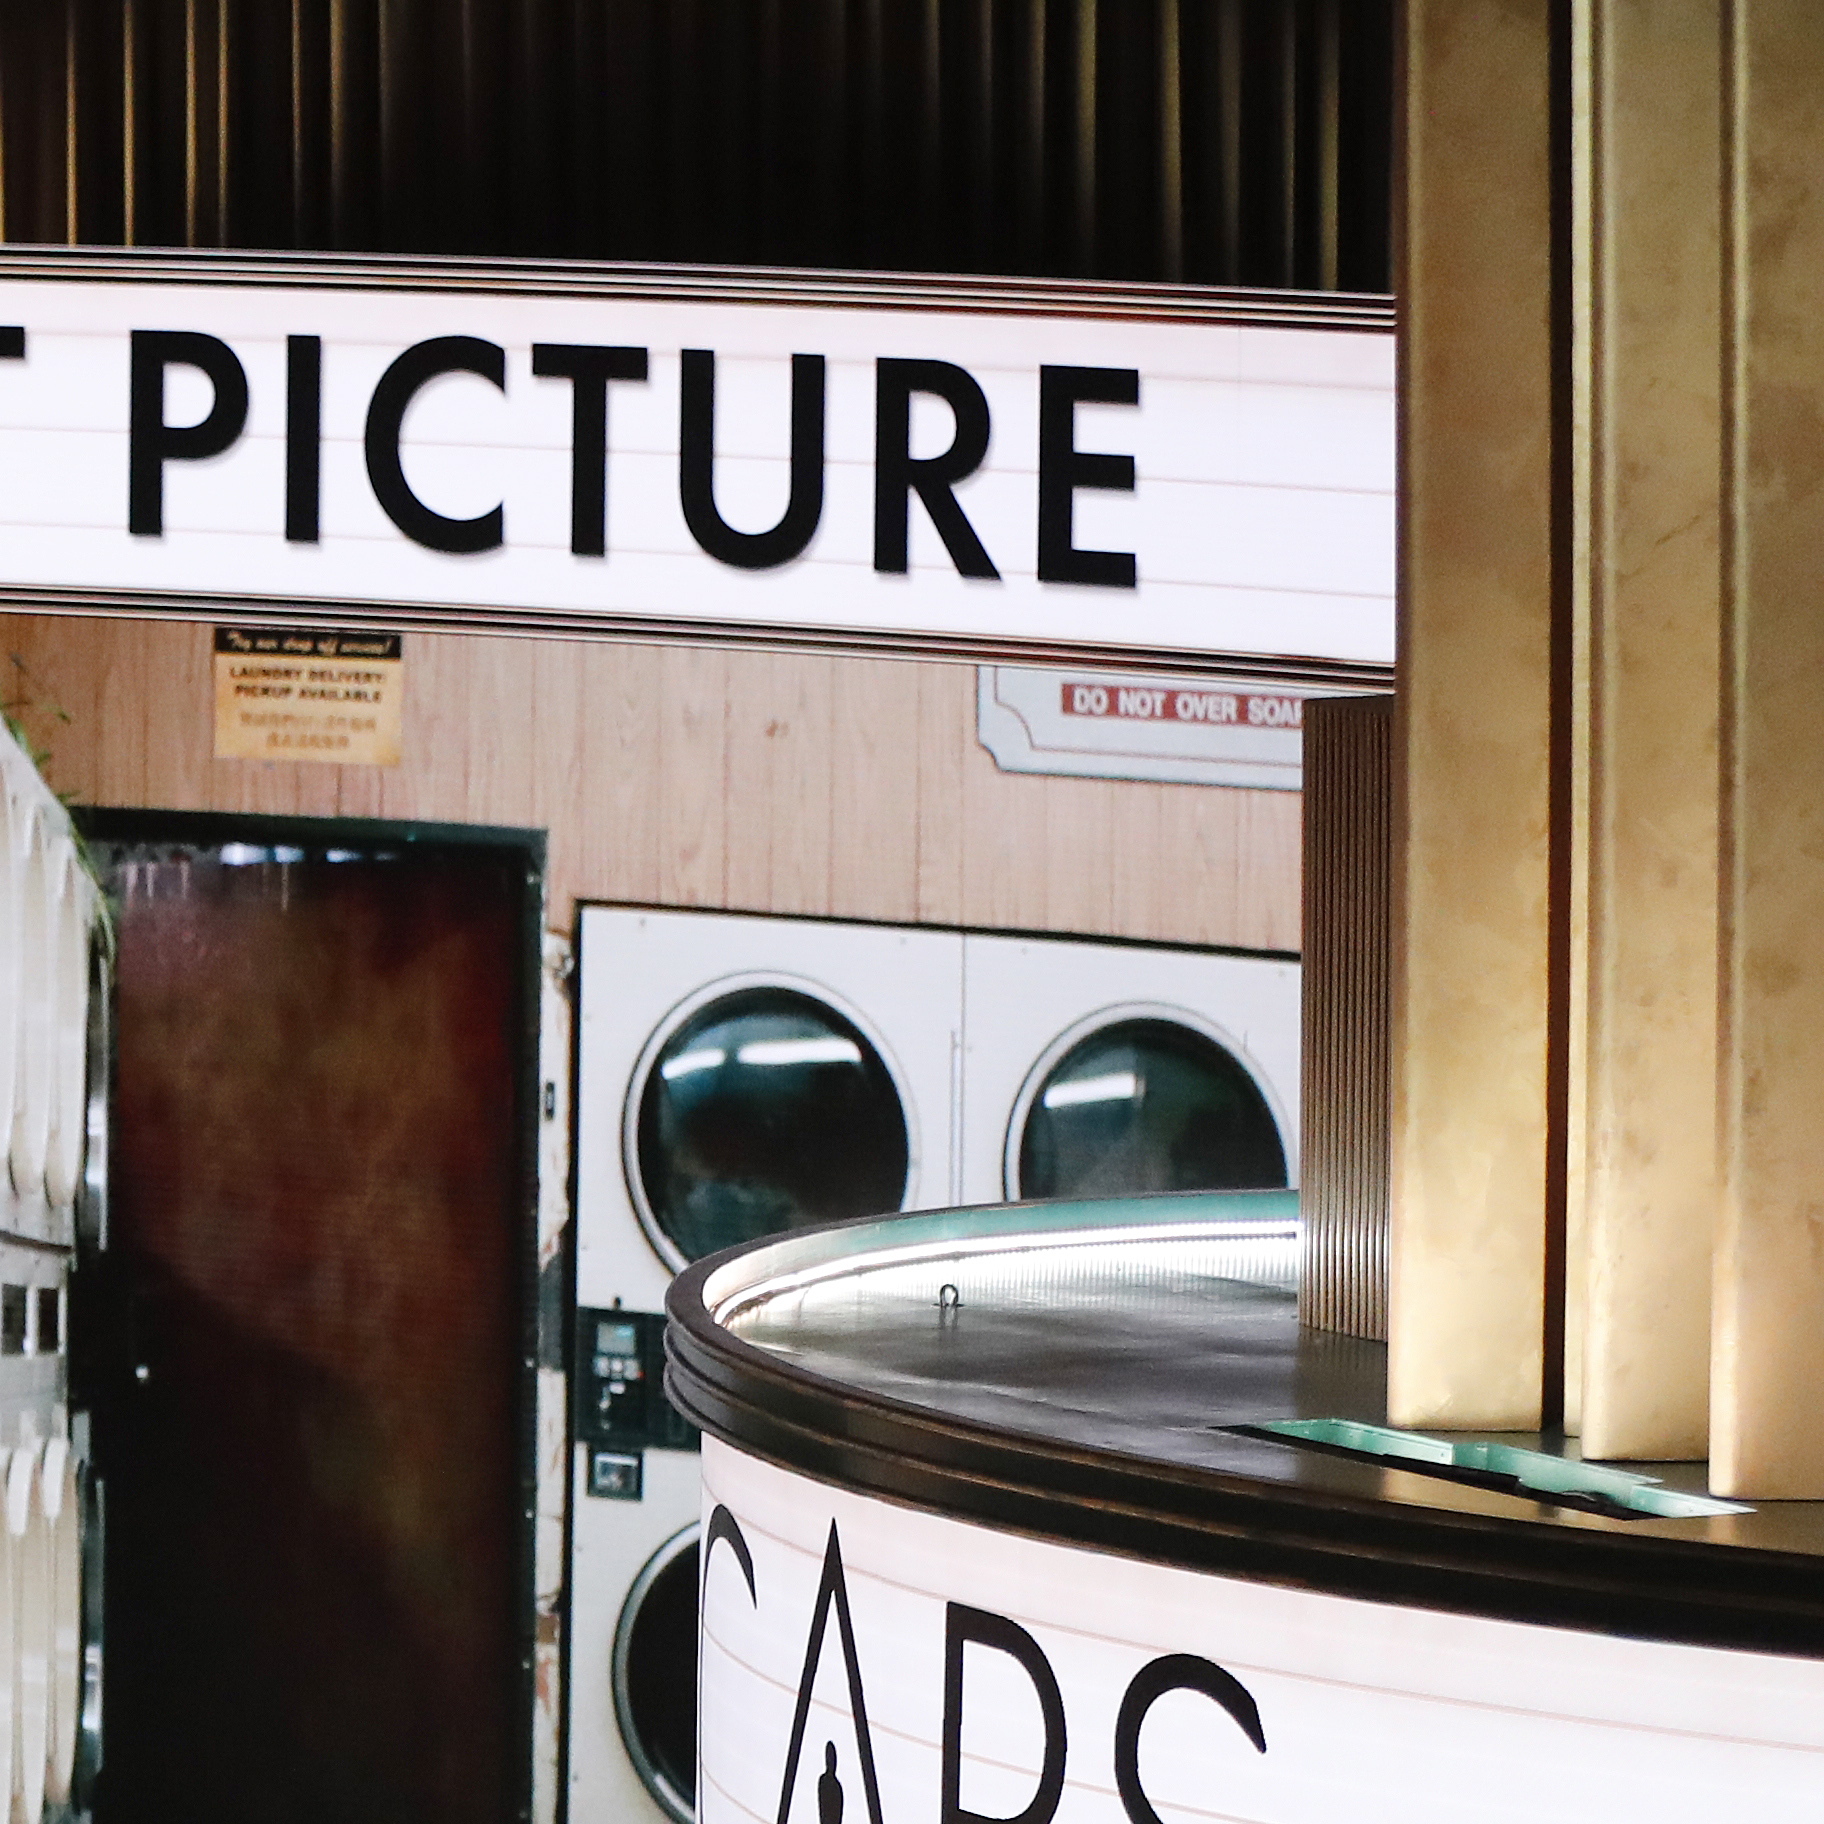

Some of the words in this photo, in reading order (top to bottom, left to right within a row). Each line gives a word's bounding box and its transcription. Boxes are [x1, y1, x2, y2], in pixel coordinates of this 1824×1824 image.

[128, 328, 1141, 591] PICTURE
[1072, 686, 1108, 715] DO
[1117, 689, 1166, 717] NOT
[1175, 693, 1237, 722] OVER
